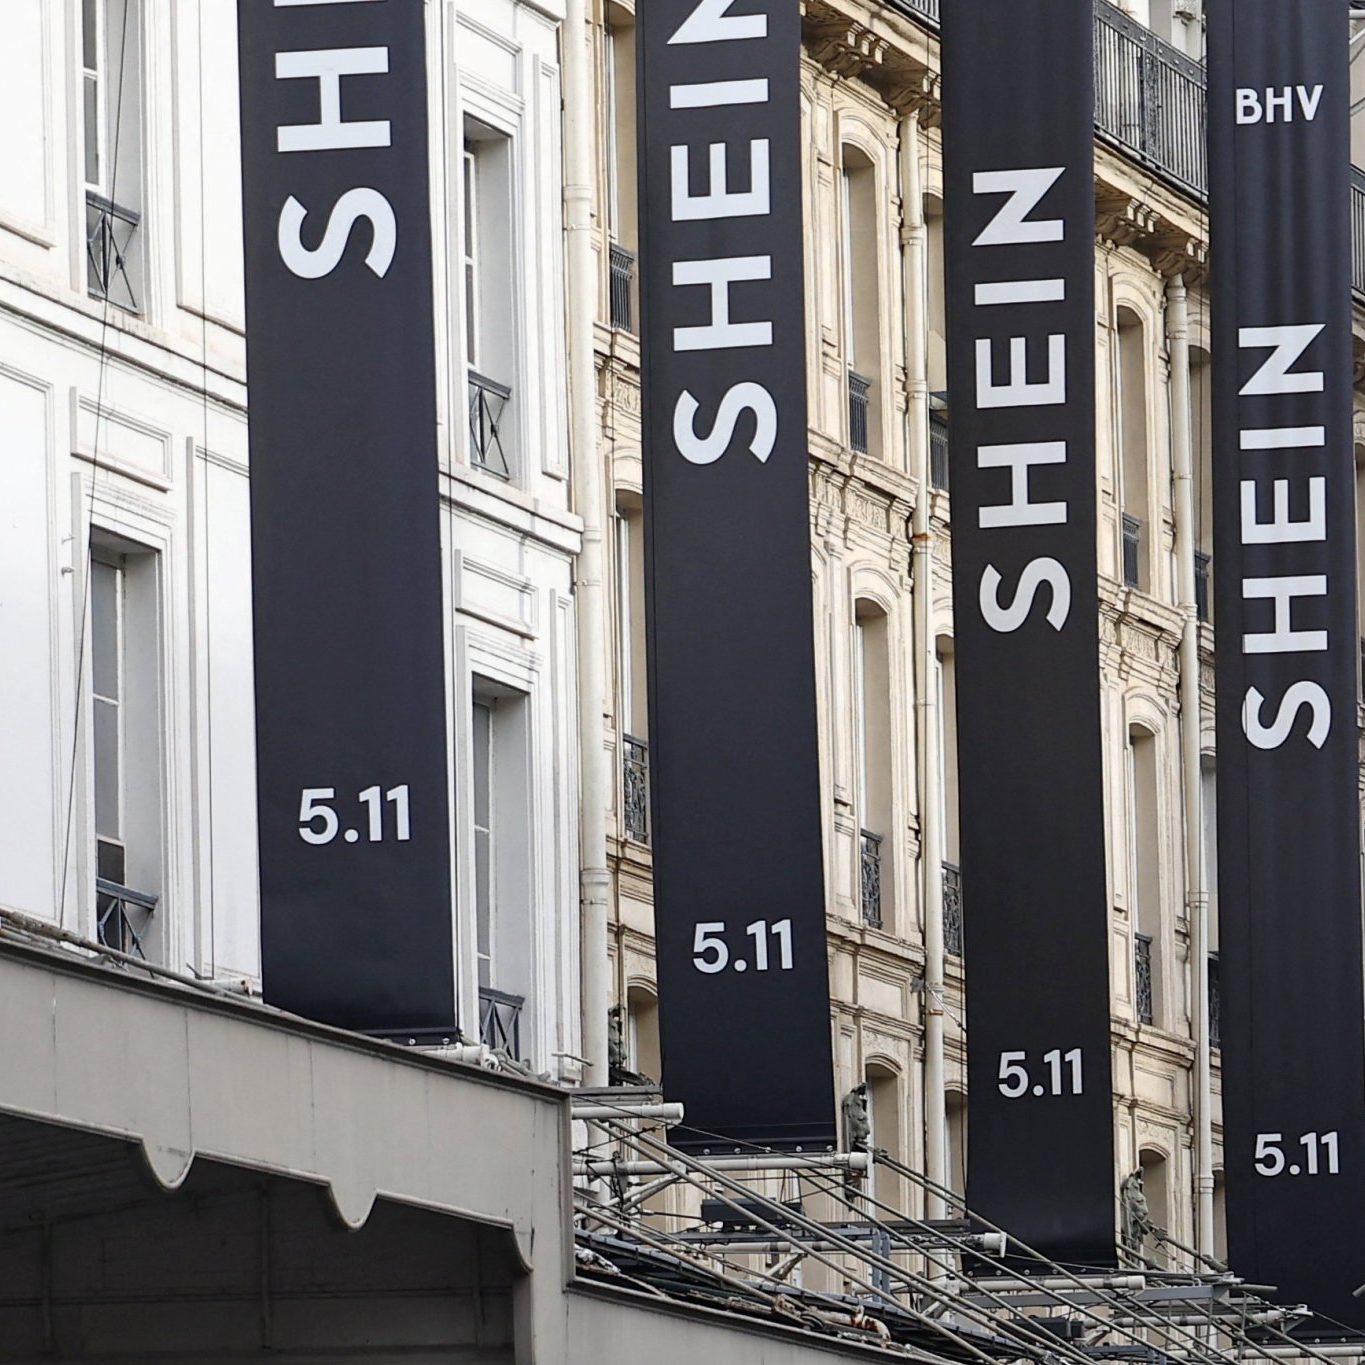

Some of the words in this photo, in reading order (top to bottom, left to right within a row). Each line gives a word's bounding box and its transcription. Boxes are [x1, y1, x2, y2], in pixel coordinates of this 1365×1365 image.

[1235, 84, 1325, 125] BHV
[274, 0, 398, 280] SH
[971, 166, 1072, 633] SHEIN
[1238, 323, 1333, 751] SHEIN
[297, 784, 411, 846] 5.11
[691, 917, 795, 975] 5.11
[997, 1047, 1084, 1099] 5.11
[1253, 1130, 1342, 1178] 5.11
